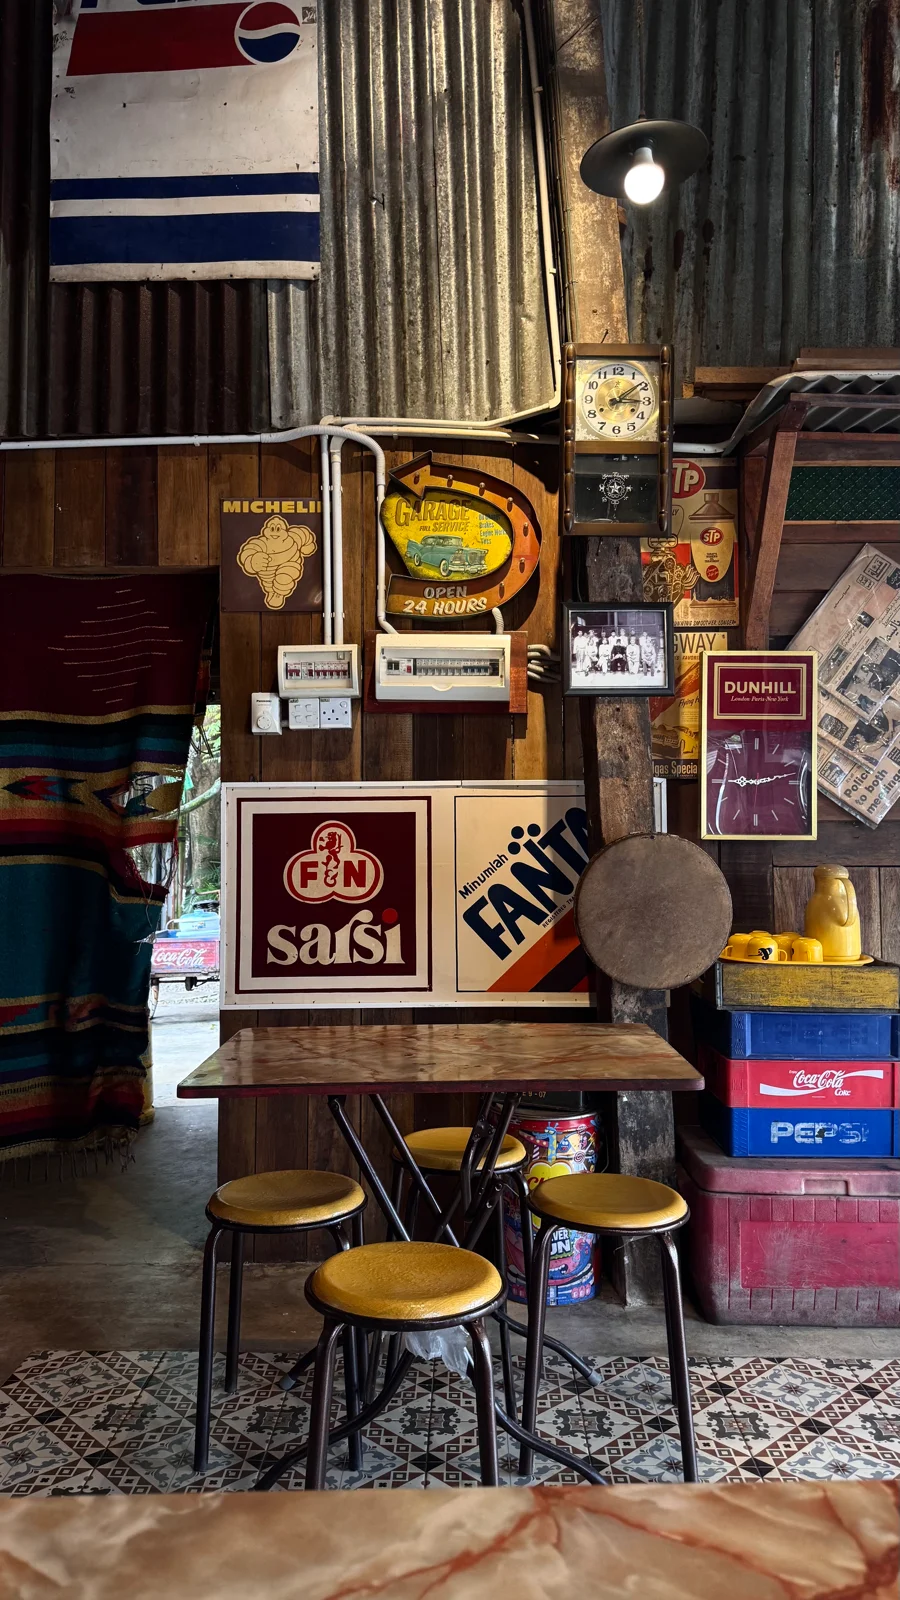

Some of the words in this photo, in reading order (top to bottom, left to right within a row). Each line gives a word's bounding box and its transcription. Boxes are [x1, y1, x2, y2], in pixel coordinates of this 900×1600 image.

[598, 371, 606, 379] 11
[612, 366, 624, 376] 12
[632, 372, 636, 380] 1
[588, 381, 598, 390] 10
[640, 382, 648, 391] 2
[584, 395, 593, 404] 9
[642, 397, 652, 406] 3
[588, 410, 596, 418] 8
[636, 411, 645, 420] 4
[598, 422, 606, 430] 7
[612, 426, 621, 434] 6
[627, 422, 636, 431] 5
[395, 499, 471, 526] GARAGE
[432, 522, 470, 532] SERVICE
[704, 529, 720, 543] STP
[423, 586, 468, 598] OPEN
[402, 600, 427, 614] 24
[432, 597, 488, 615] HOURS
[724, 682, 796, 694] DUNHILL
[864, 770, 888, 793] both
[458, 854, 508, 900] Minumlah
[542, 904, 567, 928] REGISTERED
[266, 908, 406, 966] sarsi
[793, 1070, 845, 1088] Coca-Cola
